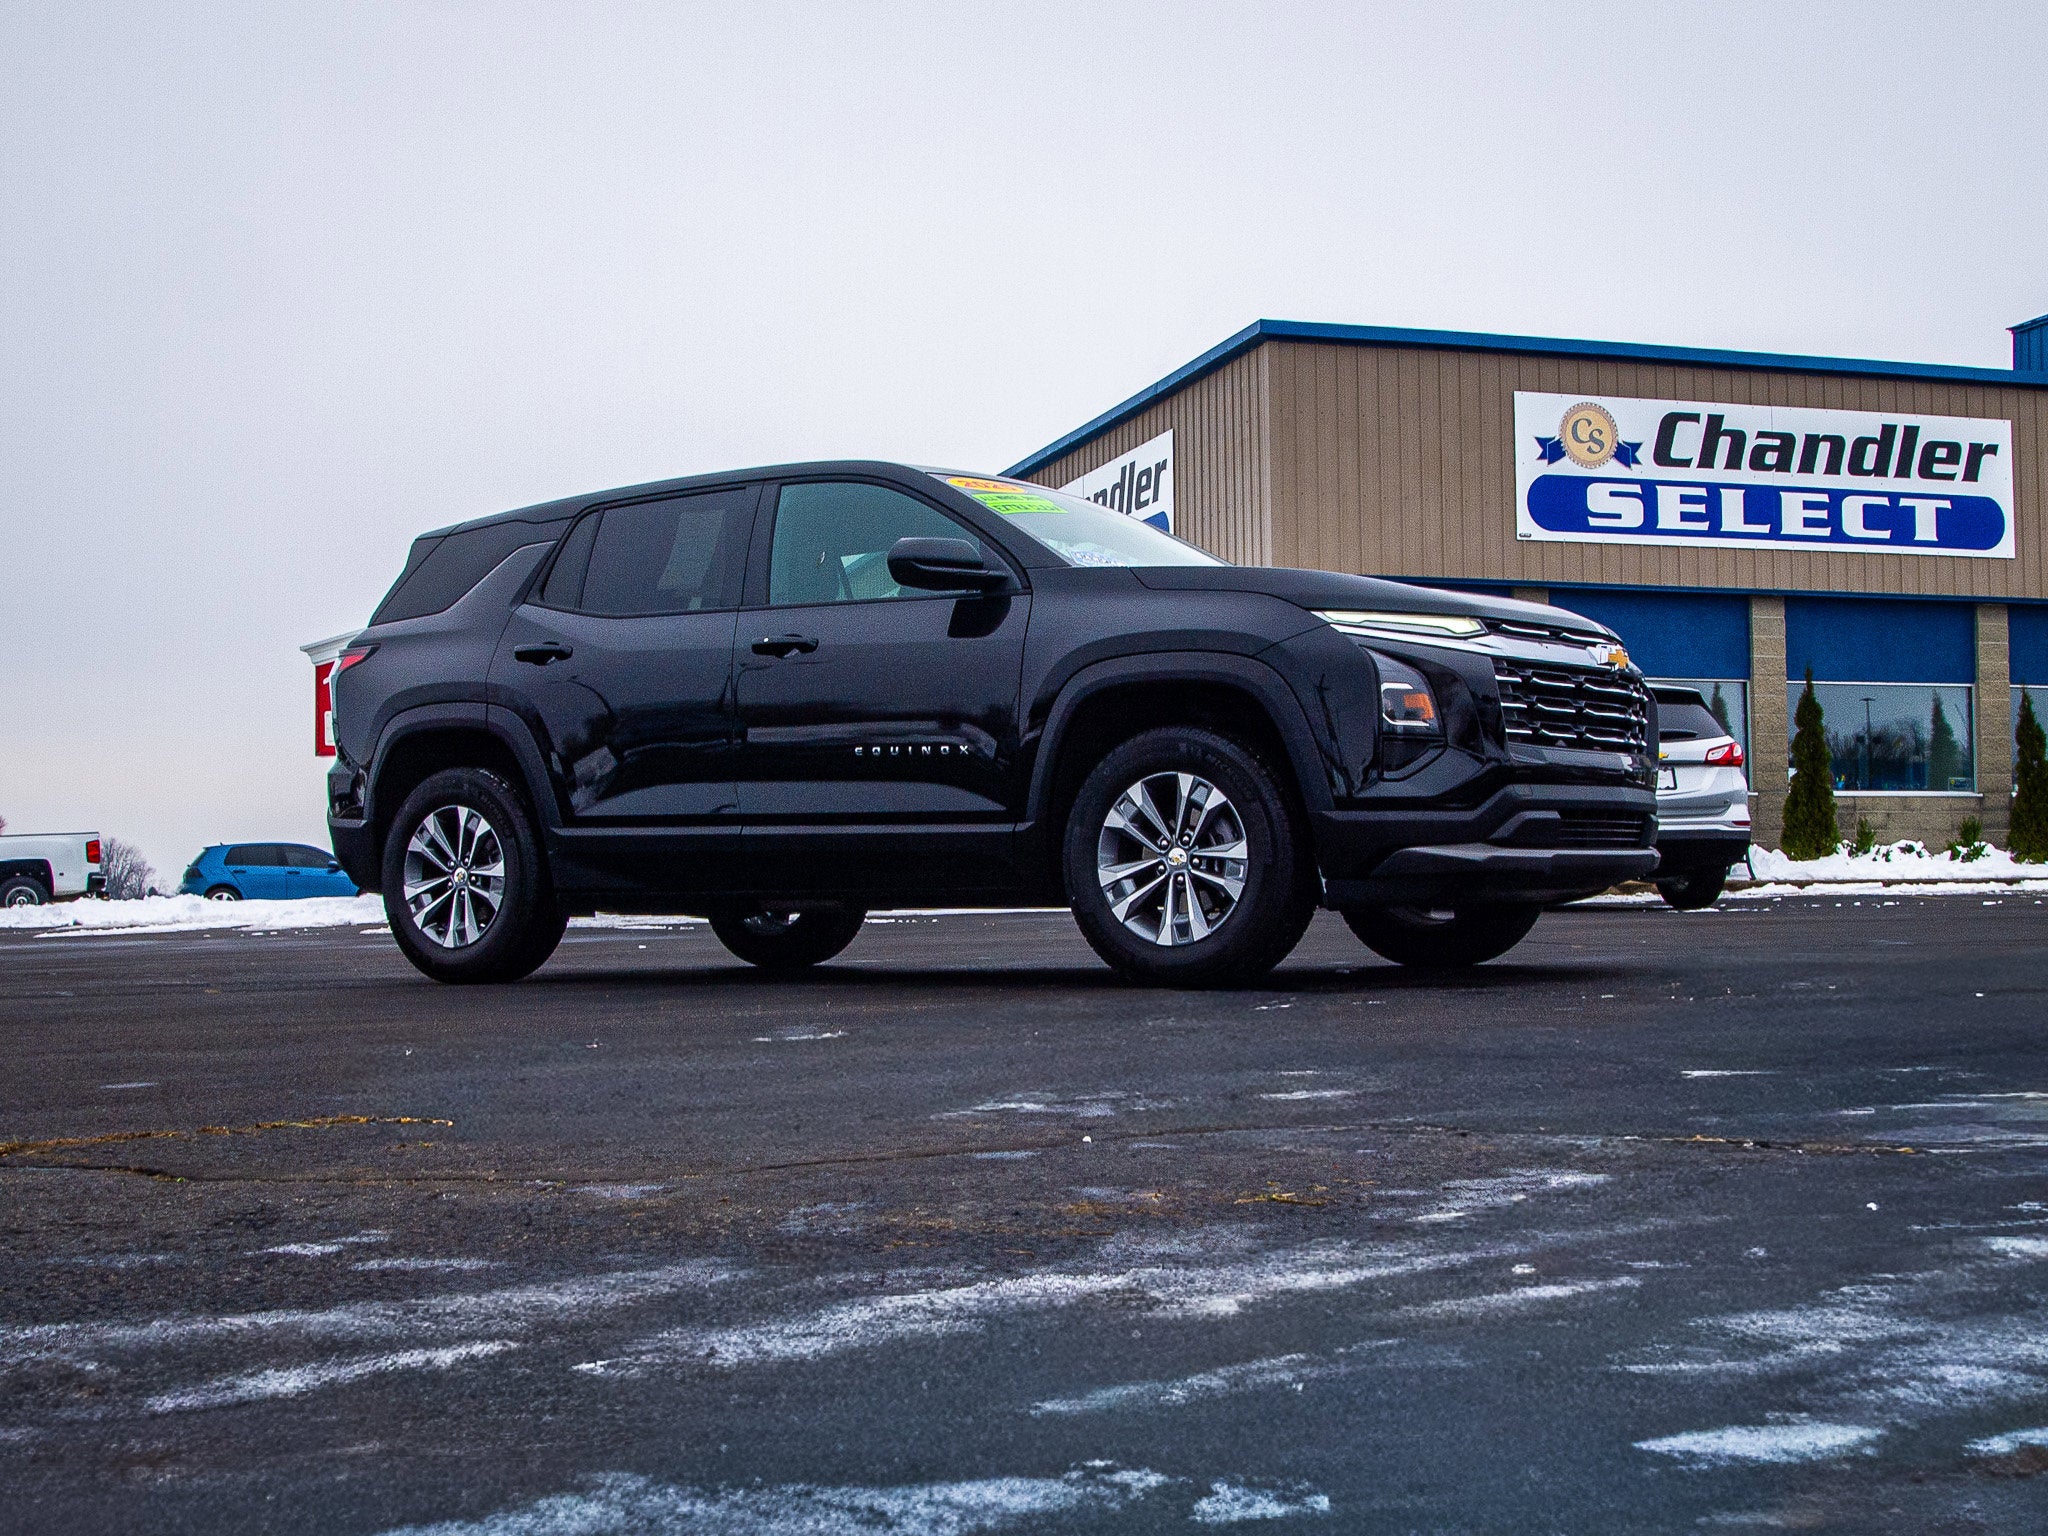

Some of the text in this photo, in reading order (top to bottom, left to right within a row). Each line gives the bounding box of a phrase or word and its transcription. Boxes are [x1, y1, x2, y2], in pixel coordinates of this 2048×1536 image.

[1571, 418, 1605, 454] CS
[1652, 411, 1999, 482] Chandler
[1585, 483, 1952, 542] SELECT
[854, 745, 969, 756] EQUINOX
